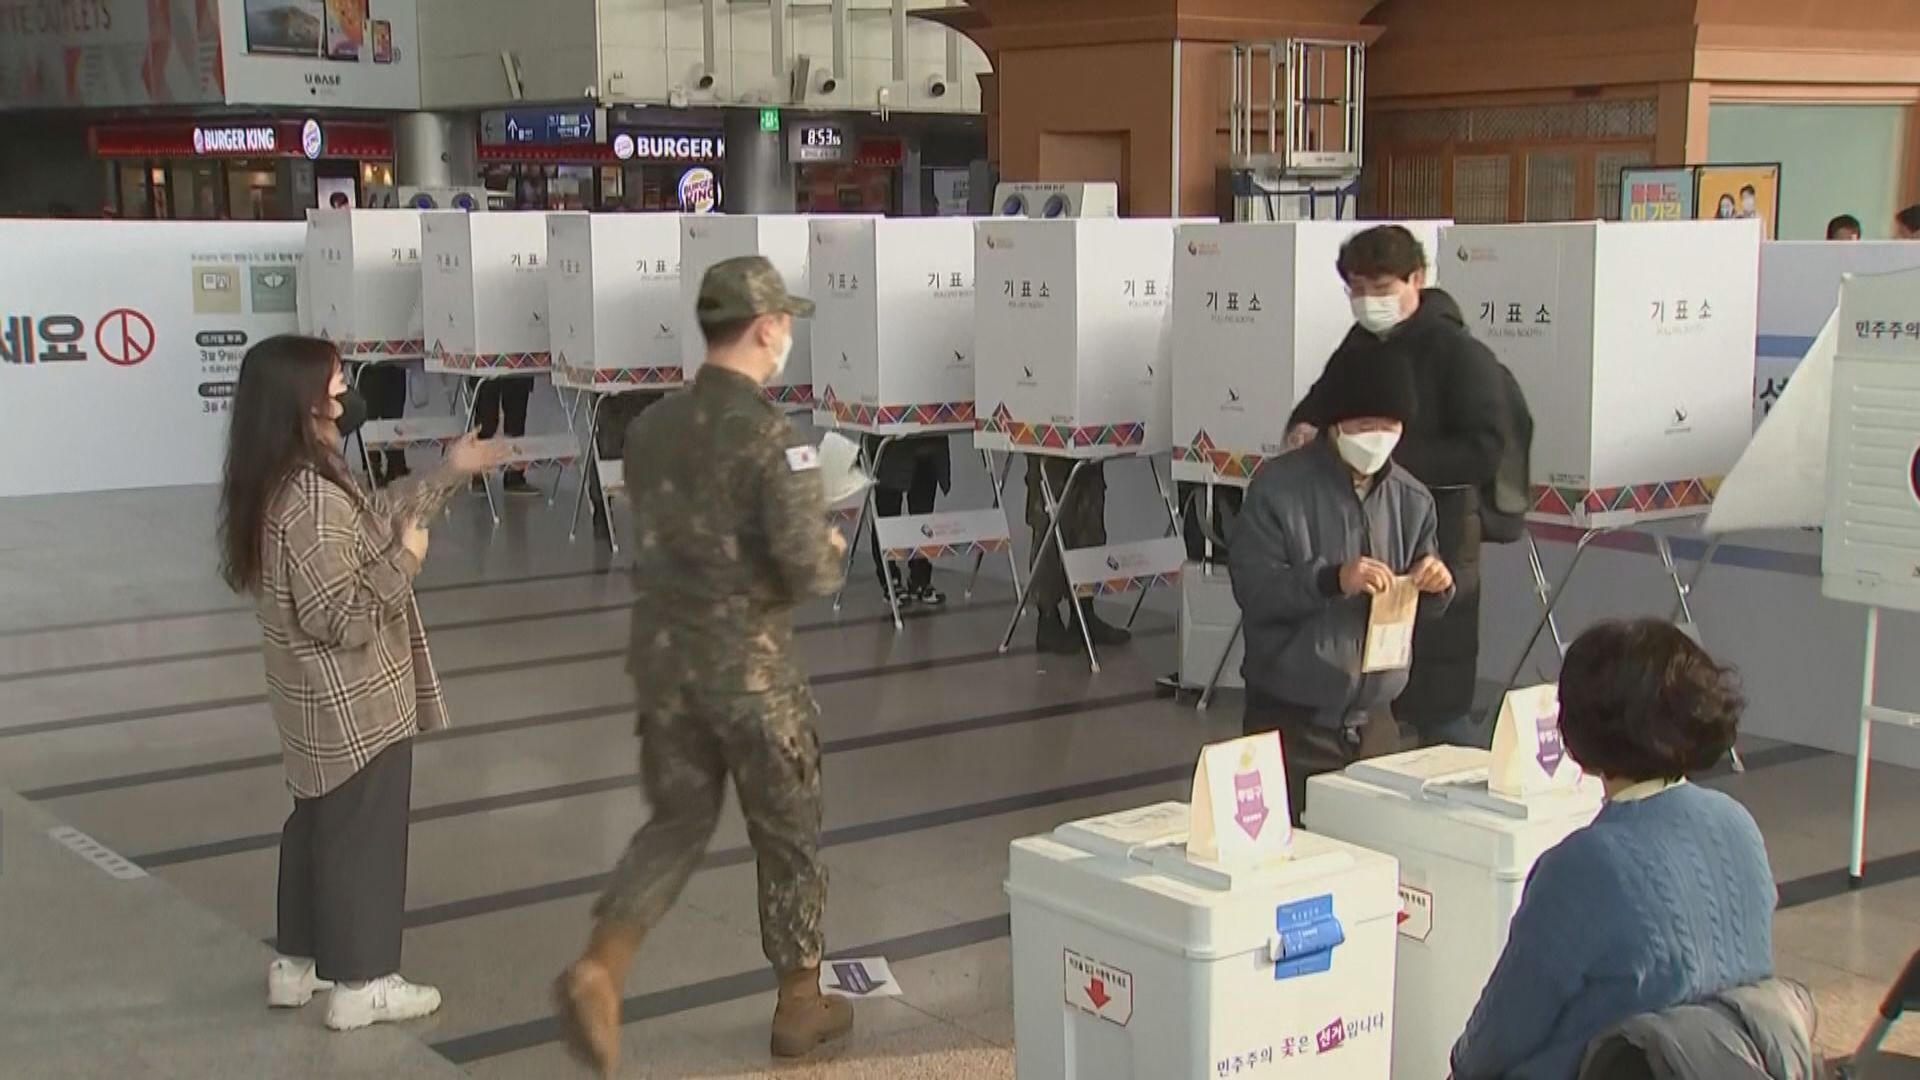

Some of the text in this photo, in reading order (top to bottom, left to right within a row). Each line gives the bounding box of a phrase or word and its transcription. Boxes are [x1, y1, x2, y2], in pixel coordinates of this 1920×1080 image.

[204, 127, 275, 150] BURGER KING
[637, 136, 713, 157] BURGER
[1217, 1045, 1273, 1078] 민주주의
[1281, 1034, 1310, 1059] 꽃은
